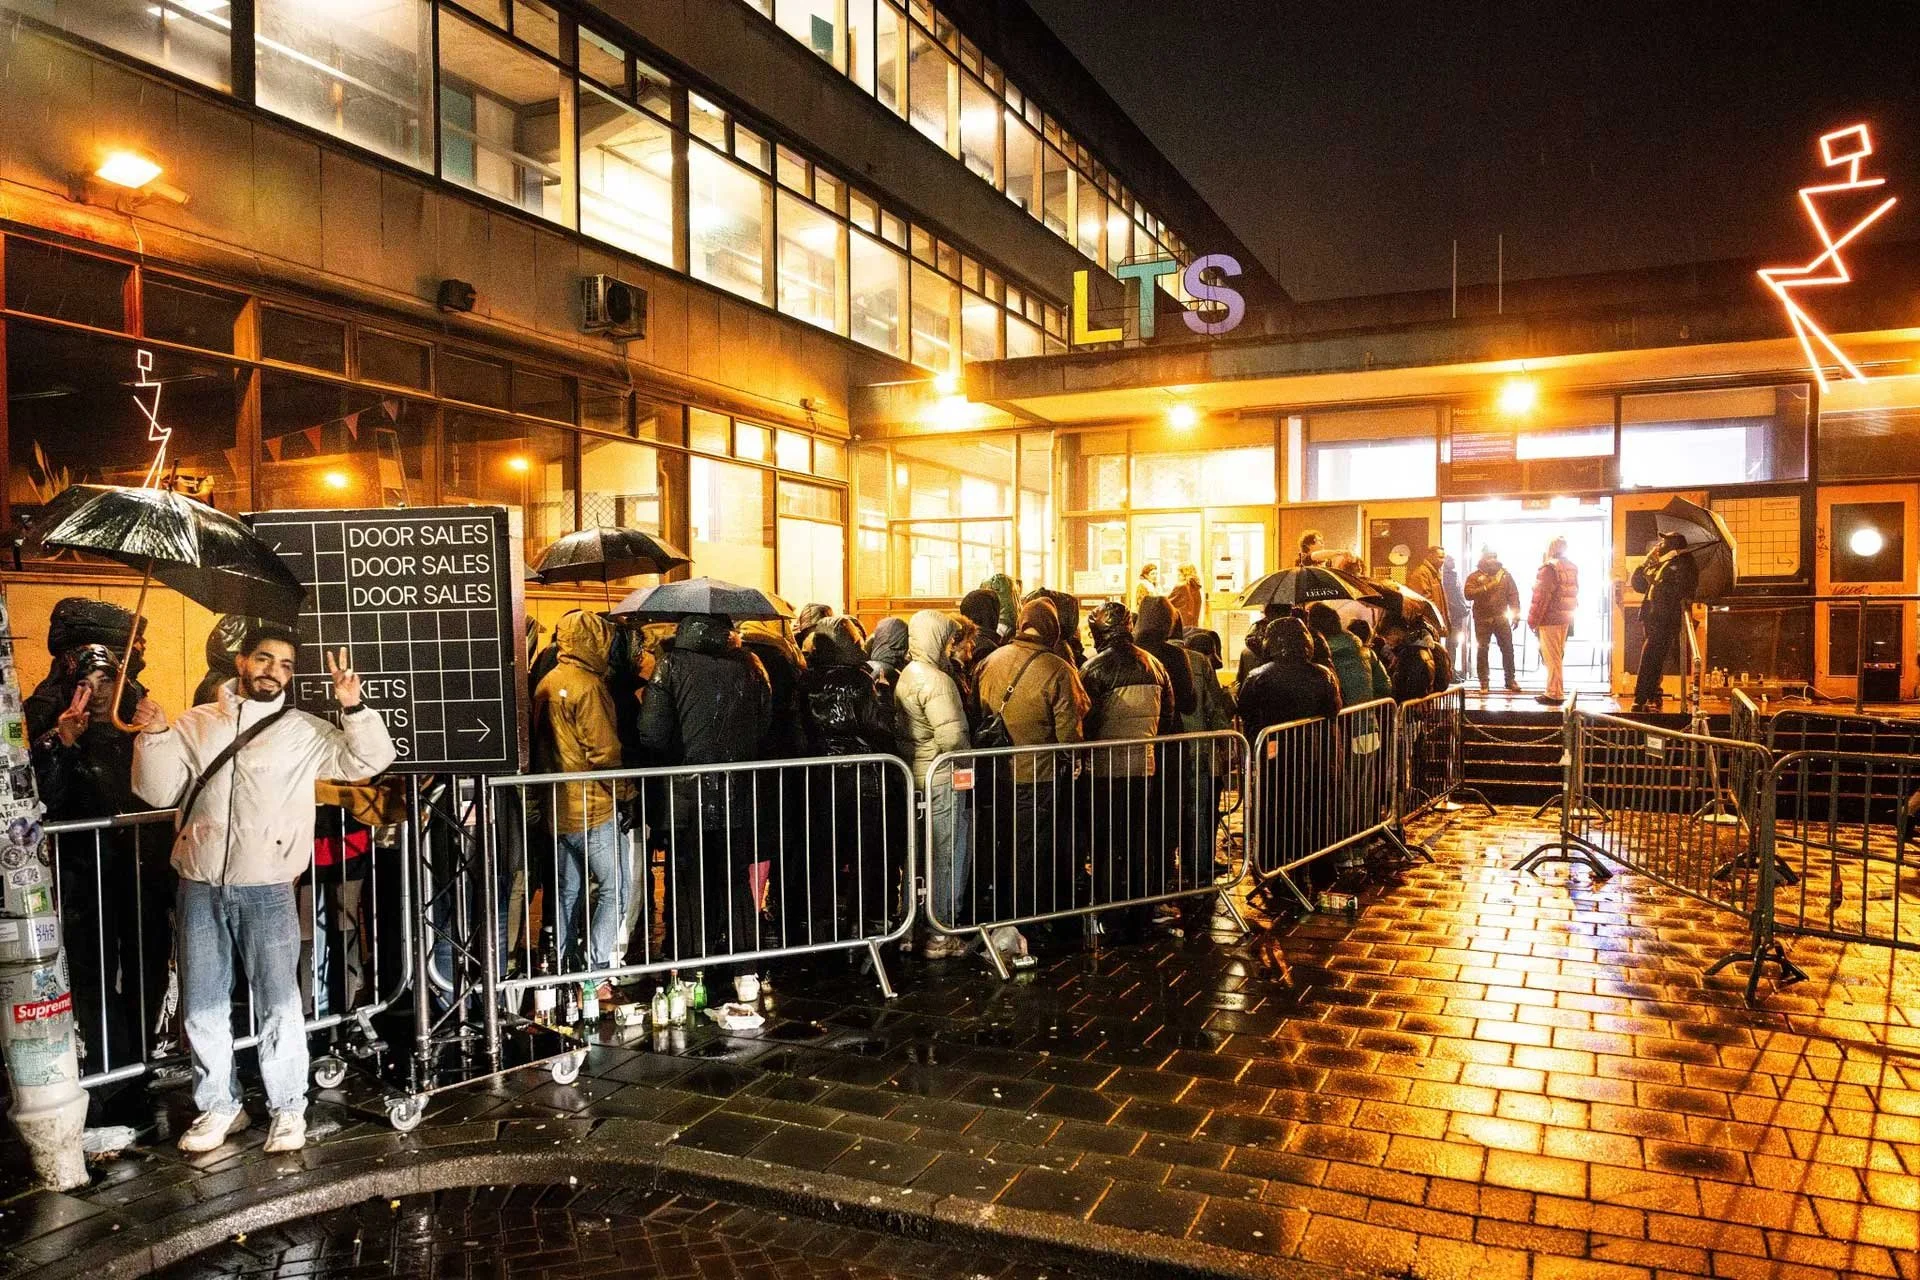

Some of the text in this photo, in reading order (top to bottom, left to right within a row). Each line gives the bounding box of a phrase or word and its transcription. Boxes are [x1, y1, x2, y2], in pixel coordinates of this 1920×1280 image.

[1073, 253, 1245, 345] LTS
[349, 524, 489, 547] DOOR SALES
[351, 554, 490, 577] DOOR SALES
[353, 584, 492, 606] DOOR SALES
[301, 679, 407, 700] E-TKETS
